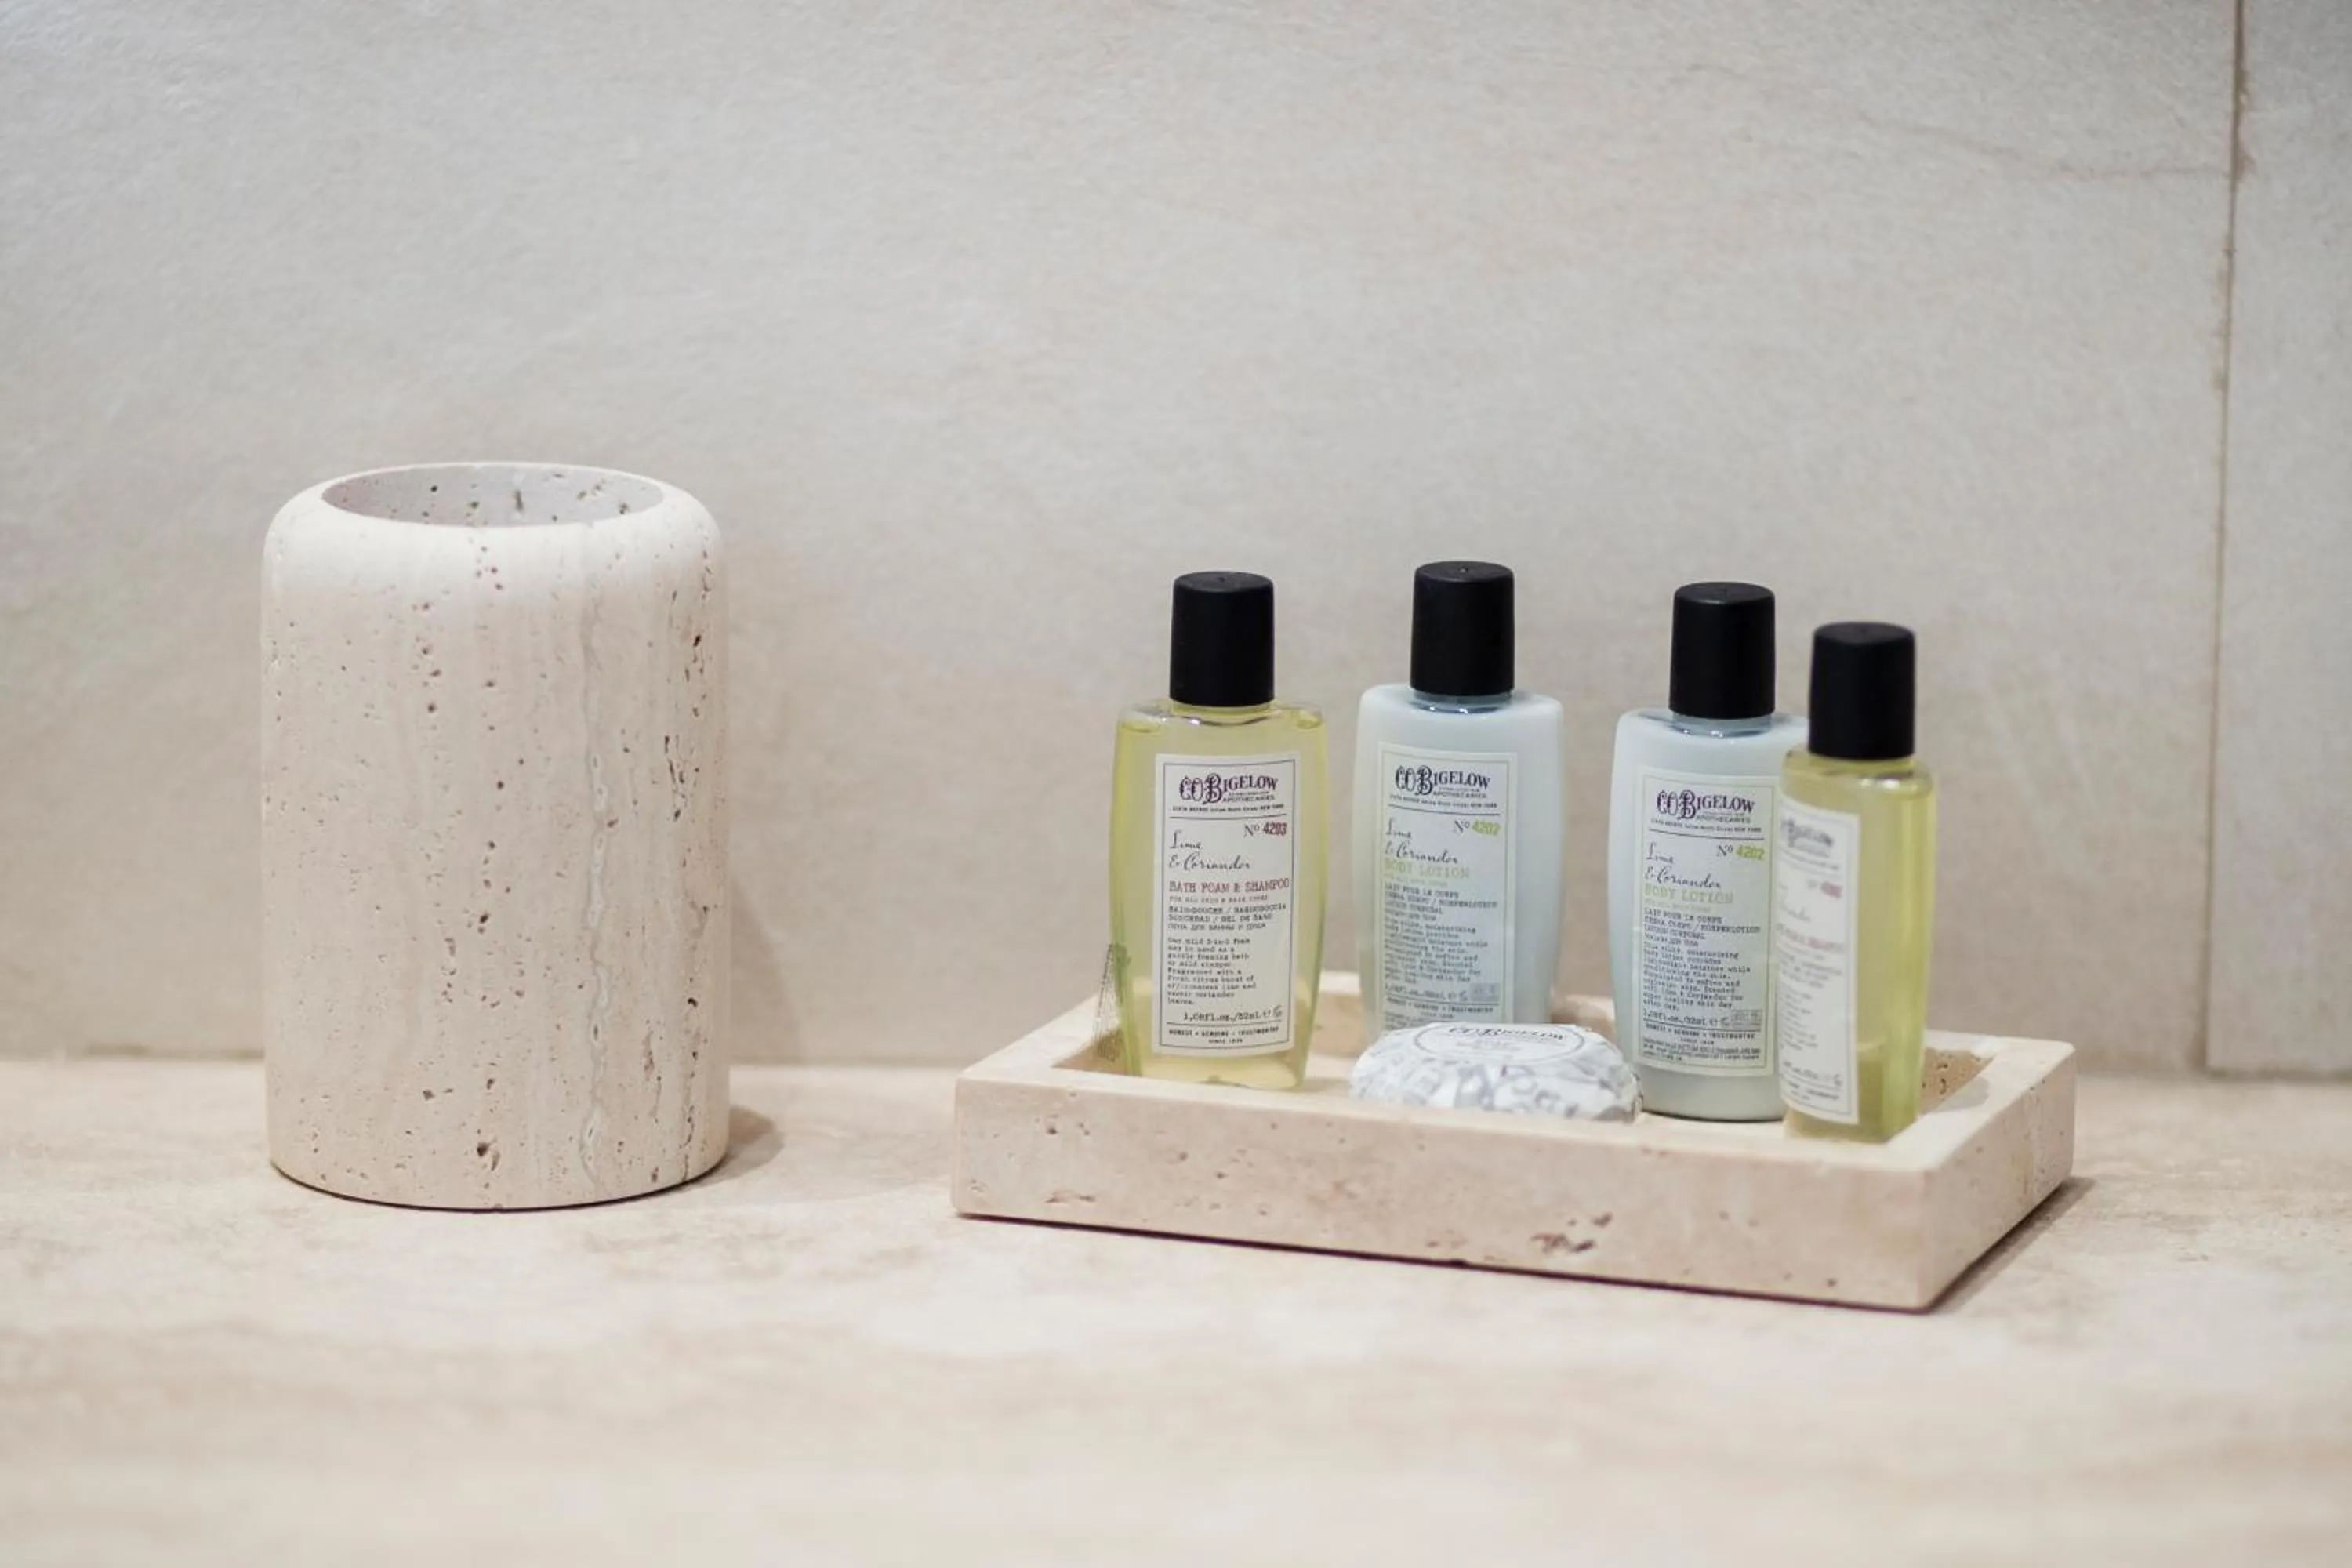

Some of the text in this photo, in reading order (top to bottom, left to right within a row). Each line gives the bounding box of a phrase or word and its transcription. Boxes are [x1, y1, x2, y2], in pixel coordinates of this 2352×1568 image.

[1203, 773, 1279, 804] BIGELOW
[1414, 764, 1491, 796] BIGELOW
[1678, 789, 1755, 820] BIGELOW
[1263, 822, 1287, 836] 4203
[1472, 819, 1501, 836] 4202
[1737, 844, 1764, 860] 4202
[1420, 865, 1469, 879] LOTION
[1170, 881, 1196, 892] BATH
[1201, 882, 1229, 892] FOAM
[1245, 878, 1289, 892] SHAMPOO
[1644, 884, 1733, 903] BODY LOTION
